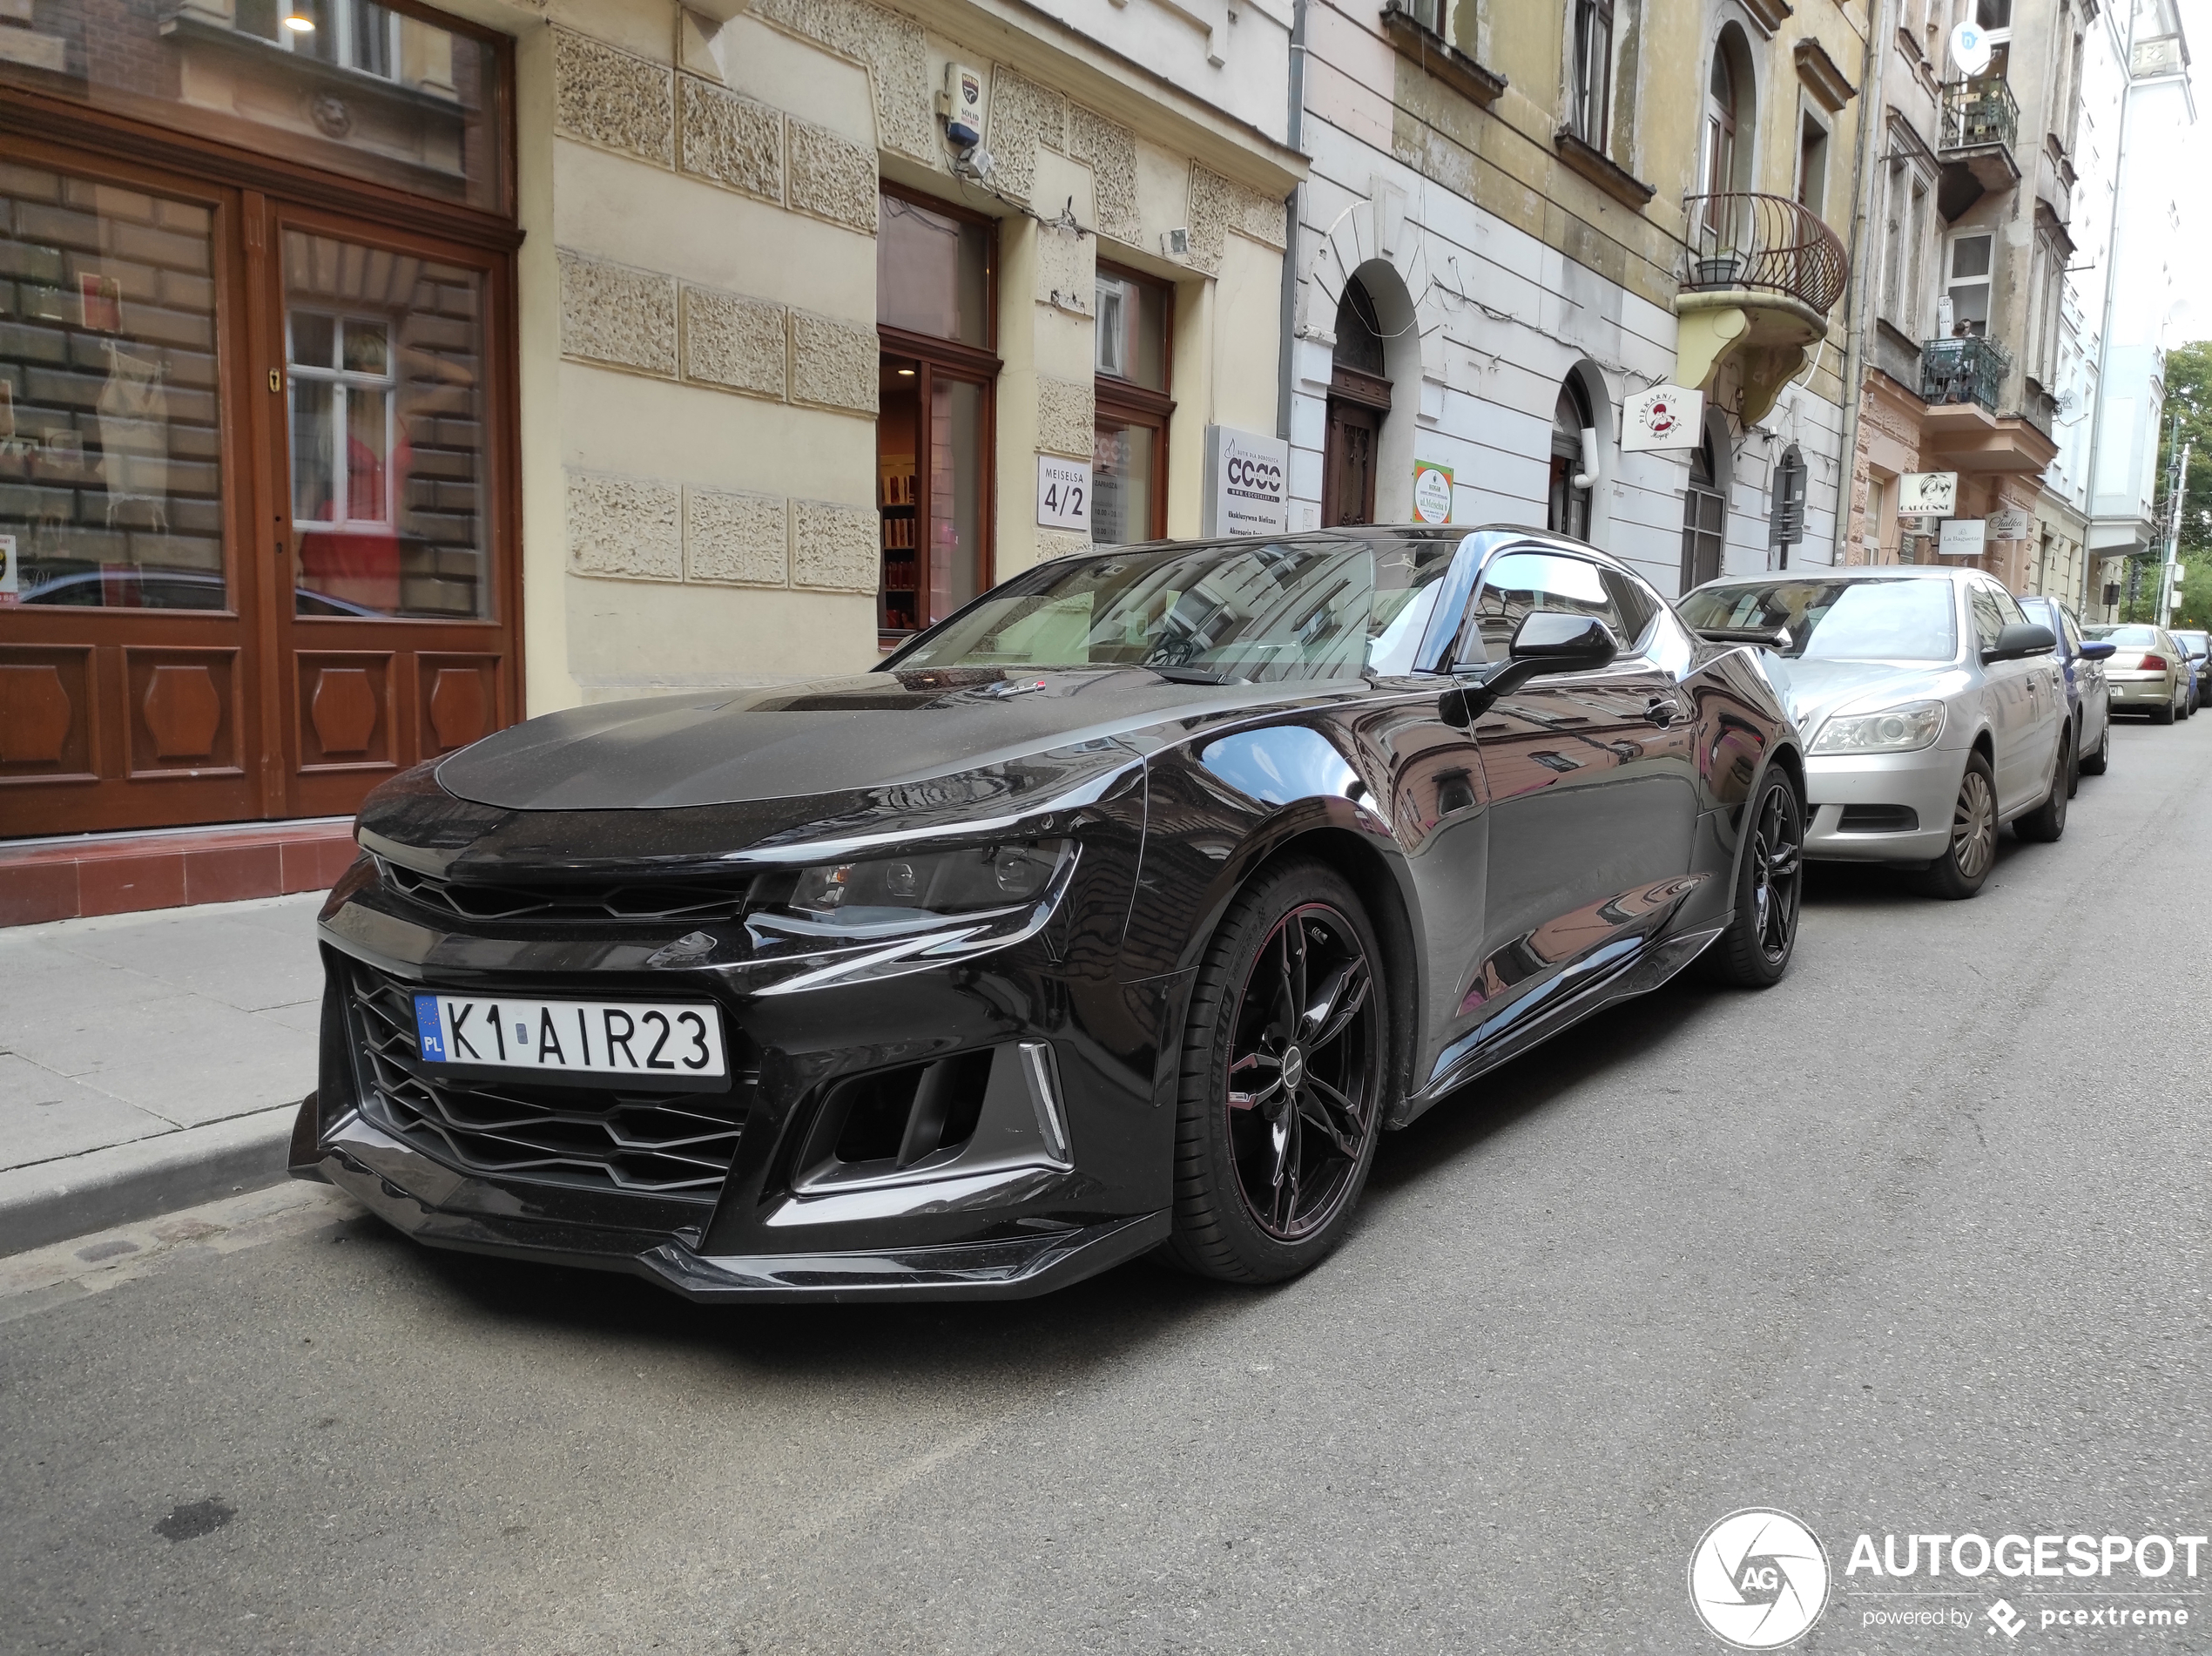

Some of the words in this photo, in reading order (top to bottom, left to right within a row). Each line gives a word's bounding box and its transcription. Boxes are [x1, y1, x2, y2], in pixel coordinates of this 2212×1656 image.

[962, 75, 979, 87] SOLID
[961, 107, 980, 121] SOLID
[1639, 393, 1676, 423] PIEKARNIA
[1045, 467, 1083, 483] MEISELSA
[1044, 483, 1083, 517] 4/2
[1228, 510, 1258, 522] Ekskluzywna
[1258, 515, 1277, 524] Bielizna
[423, 1036, 442, 1052] PL
[1211, 991, 1232, 1140] MICHELIN
